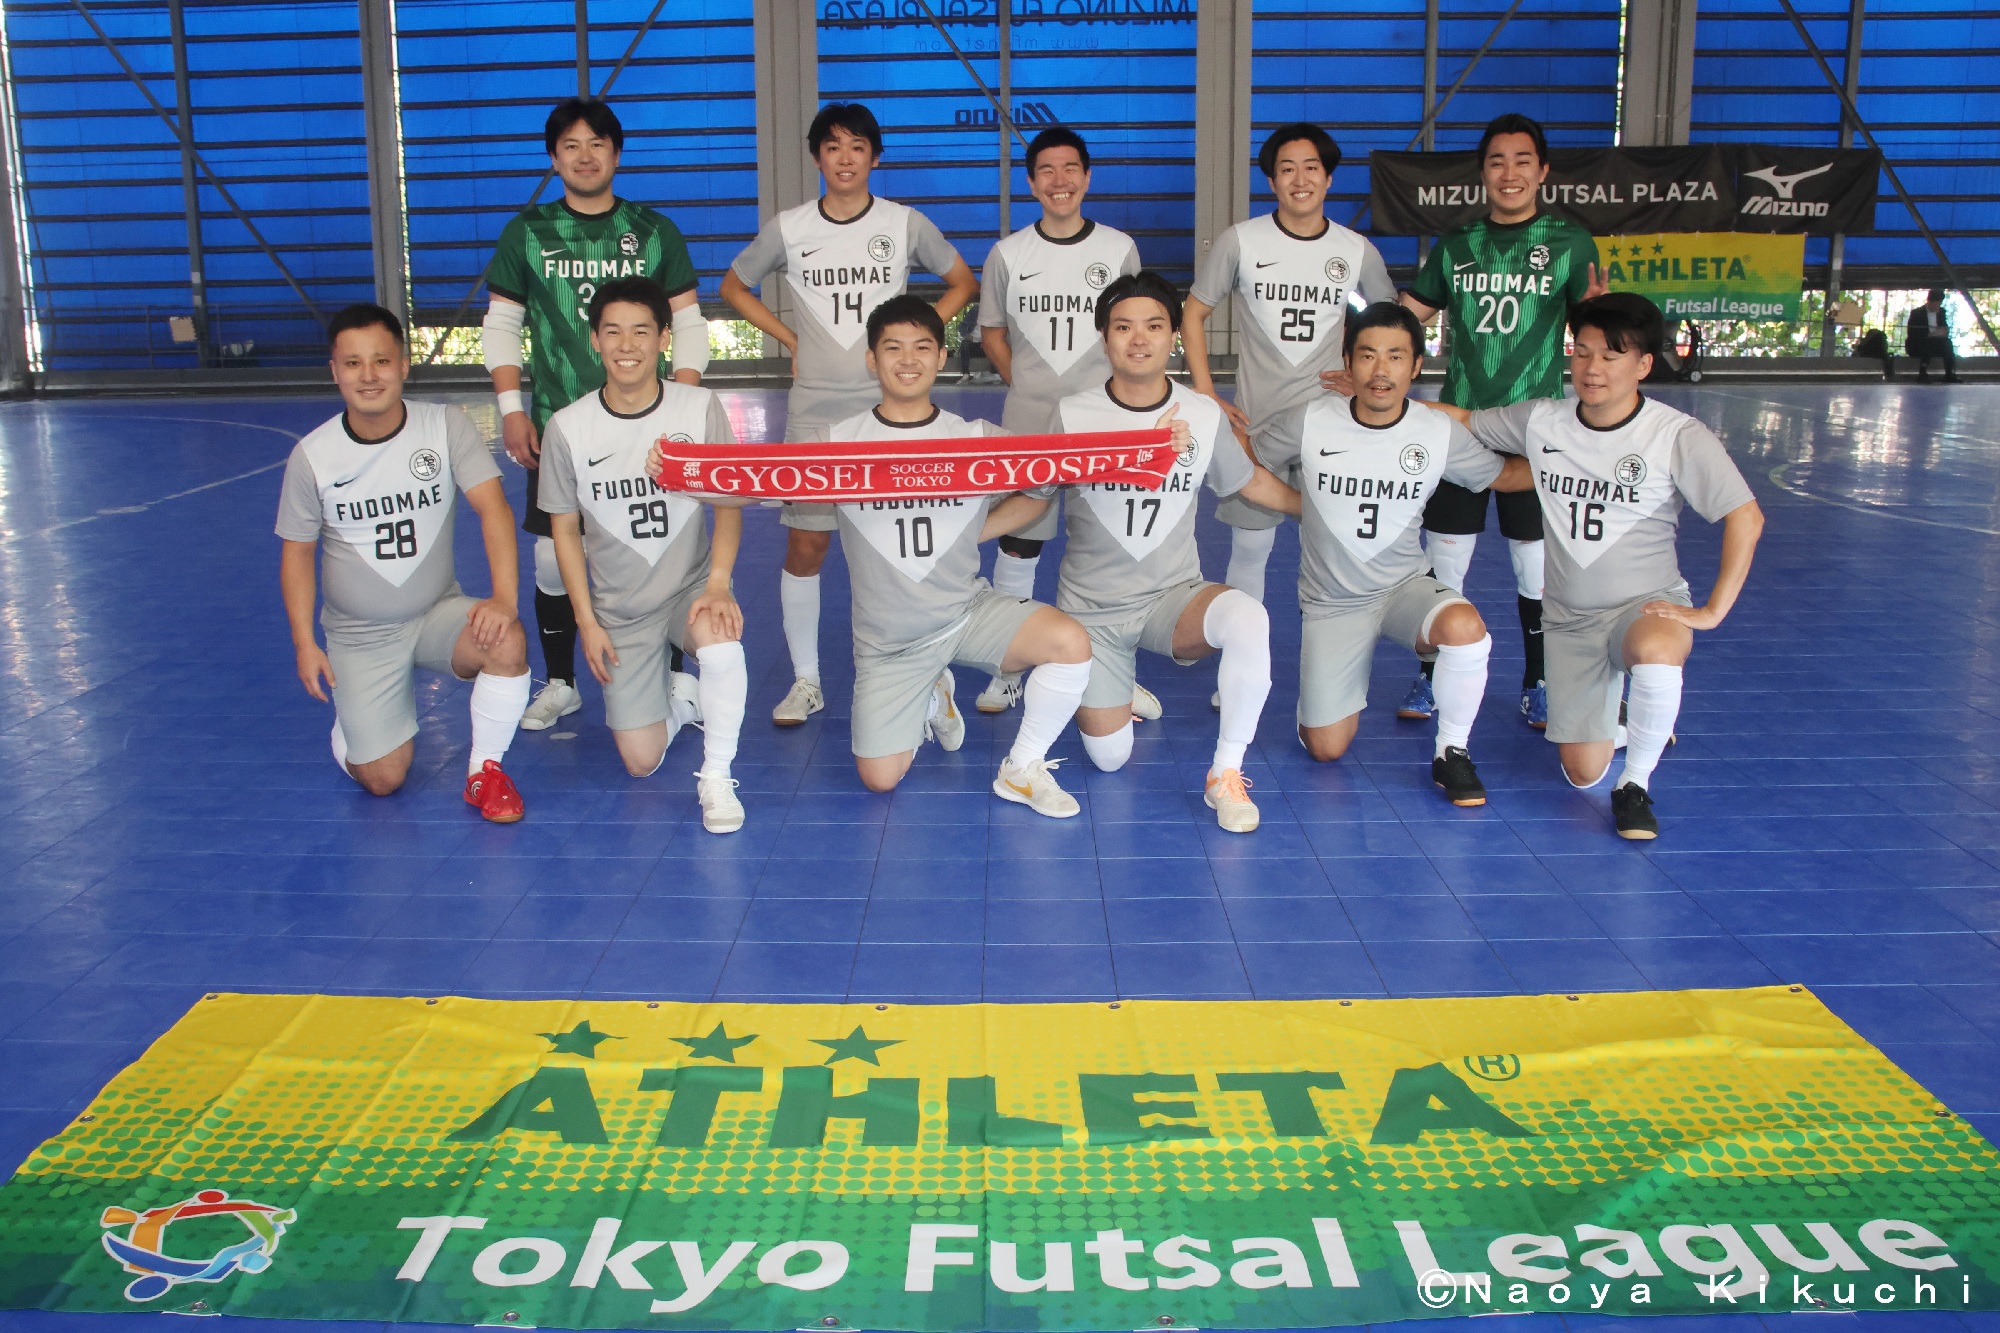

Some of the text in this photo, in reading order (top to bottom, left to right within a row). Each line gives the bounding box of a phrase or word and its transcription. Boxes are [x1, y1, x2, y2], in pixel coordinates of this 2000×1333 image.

[1418, 181, 1718, 206] MIZU UTSAL PLAZA
[545, 259, 646, 278] FUDOMAE
[802, 266, 892, 287] FUDOMAE
[1452, 273, 1553, 296] FUDOMAE
[831, 291, 863, 325] 14
[1019, 294, 1099, 313] FUDOMA
[1254, 282, 1343, 305] FUDOMAE
[1665, 298, 1784, 319] Futsal League
[1280, 307, 1316, 342] 25
[1475, 294, 1520, 333] 20
[1049, 316, 1074, 351] 11
[709, 464, 875, 493] GYOSEI
[889, 462, 955, 475] SOCCER
[892, 475, 951, 488] TOKYO
[335, 483, 442, 521] FUDOMAE
[1318, 472, 1424, 500] FUDOMAE
[1540, 470, 1640, 503] FUDOMAE
[628, 499, 669, 539] 29
[1125, 498, 1161, 537] 17
[1356, 502, 1380, 540] 3
[1568, 501, 1606, 541] 16
[375, 518, 418, 560] 28
[895, 516, 934, 558] 10
[394, 1215, 1959, 1314] Tokyo Futsal League
